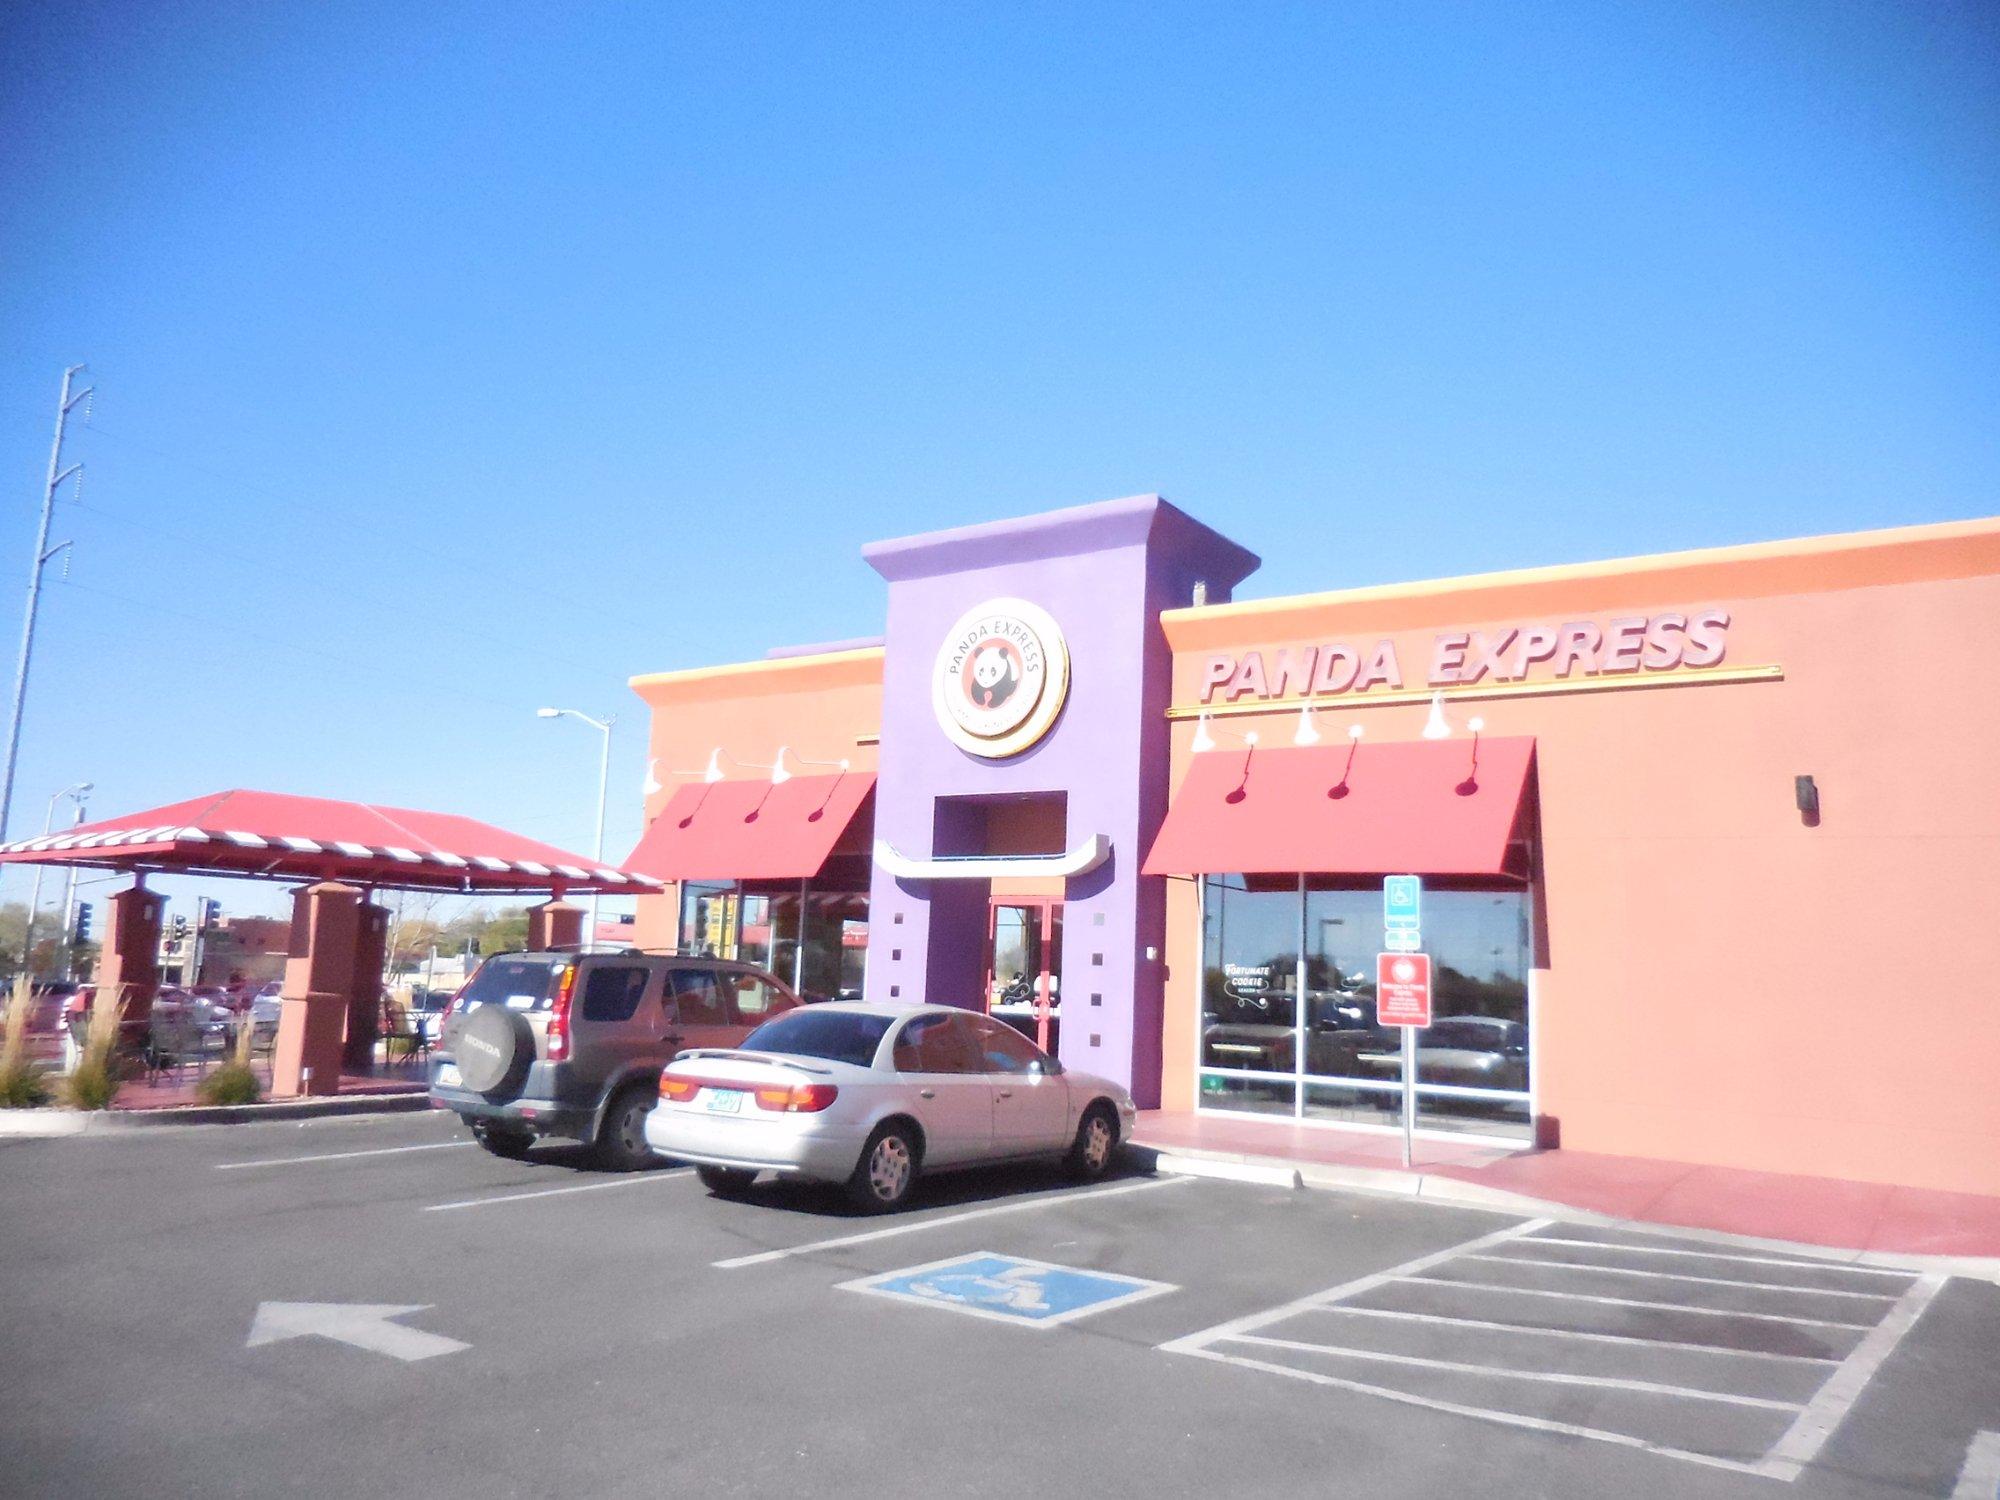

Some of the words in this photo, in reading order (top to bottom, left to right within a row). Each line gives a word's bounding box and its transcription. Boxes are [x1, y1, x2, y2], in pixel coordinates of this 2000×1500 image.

[950, 625, 988, 674] PANDA
[994, 621, 1039, 673] EXPRESS
[1200, 639, 1403, 703] PANDA
[1428, 608, 1731, 687] EXPRESS
[1225, 964, 1269, 976] FORTUNATE
[1231, 977, 1263, 987] COOKIE
[464, 1034, 501, 1058] HONDA
